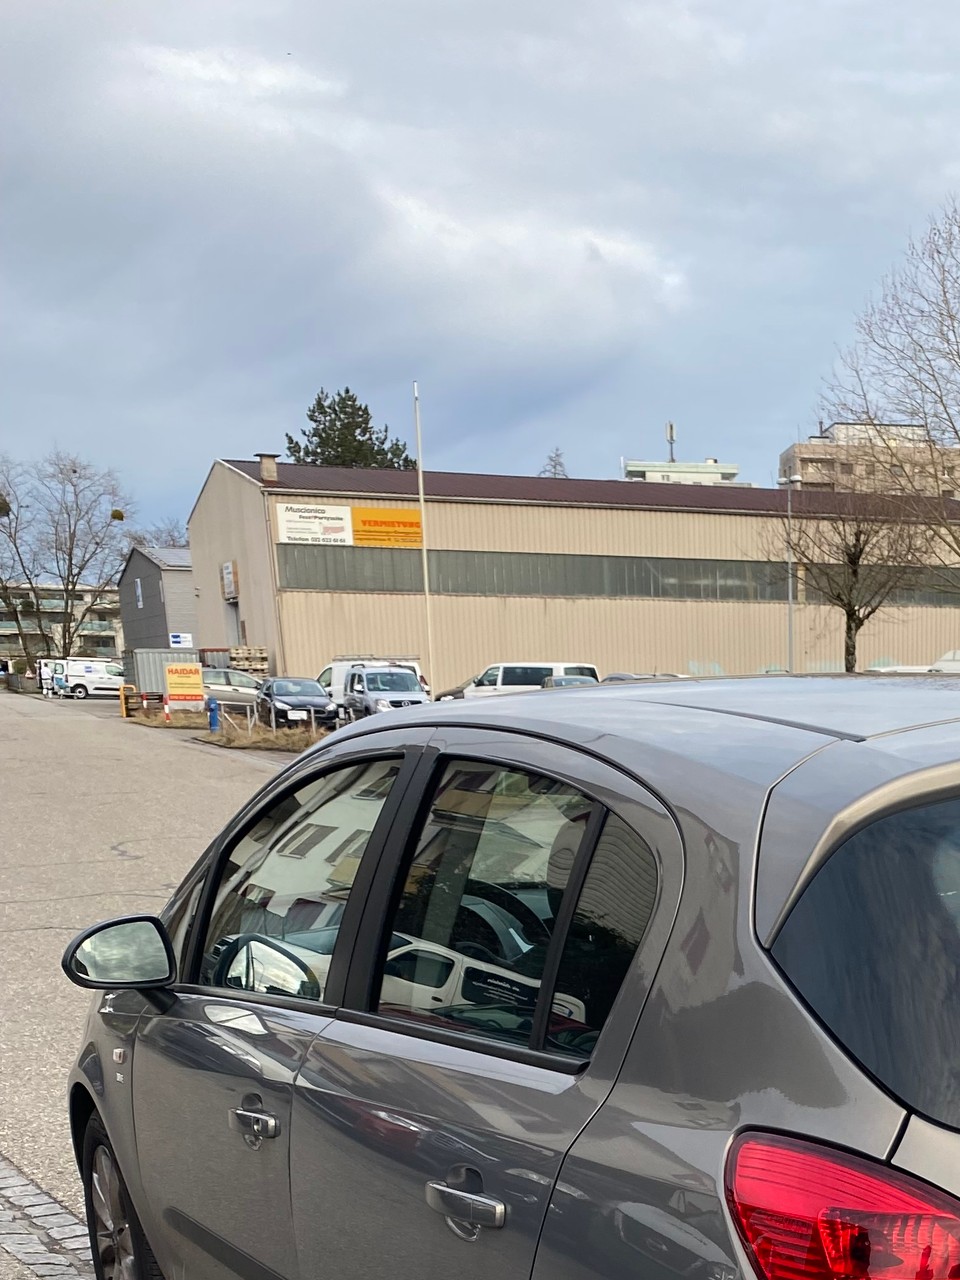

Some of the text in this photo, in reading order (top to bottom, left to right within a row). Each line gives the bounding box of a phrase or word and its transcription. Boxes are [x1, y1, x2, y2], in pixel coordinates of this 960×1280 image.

[284, 506, 326, 514] Muscionico
[361, 519, 420, 528] VERMIETUNG
[167, 667, 200, 675] HAIDAR
